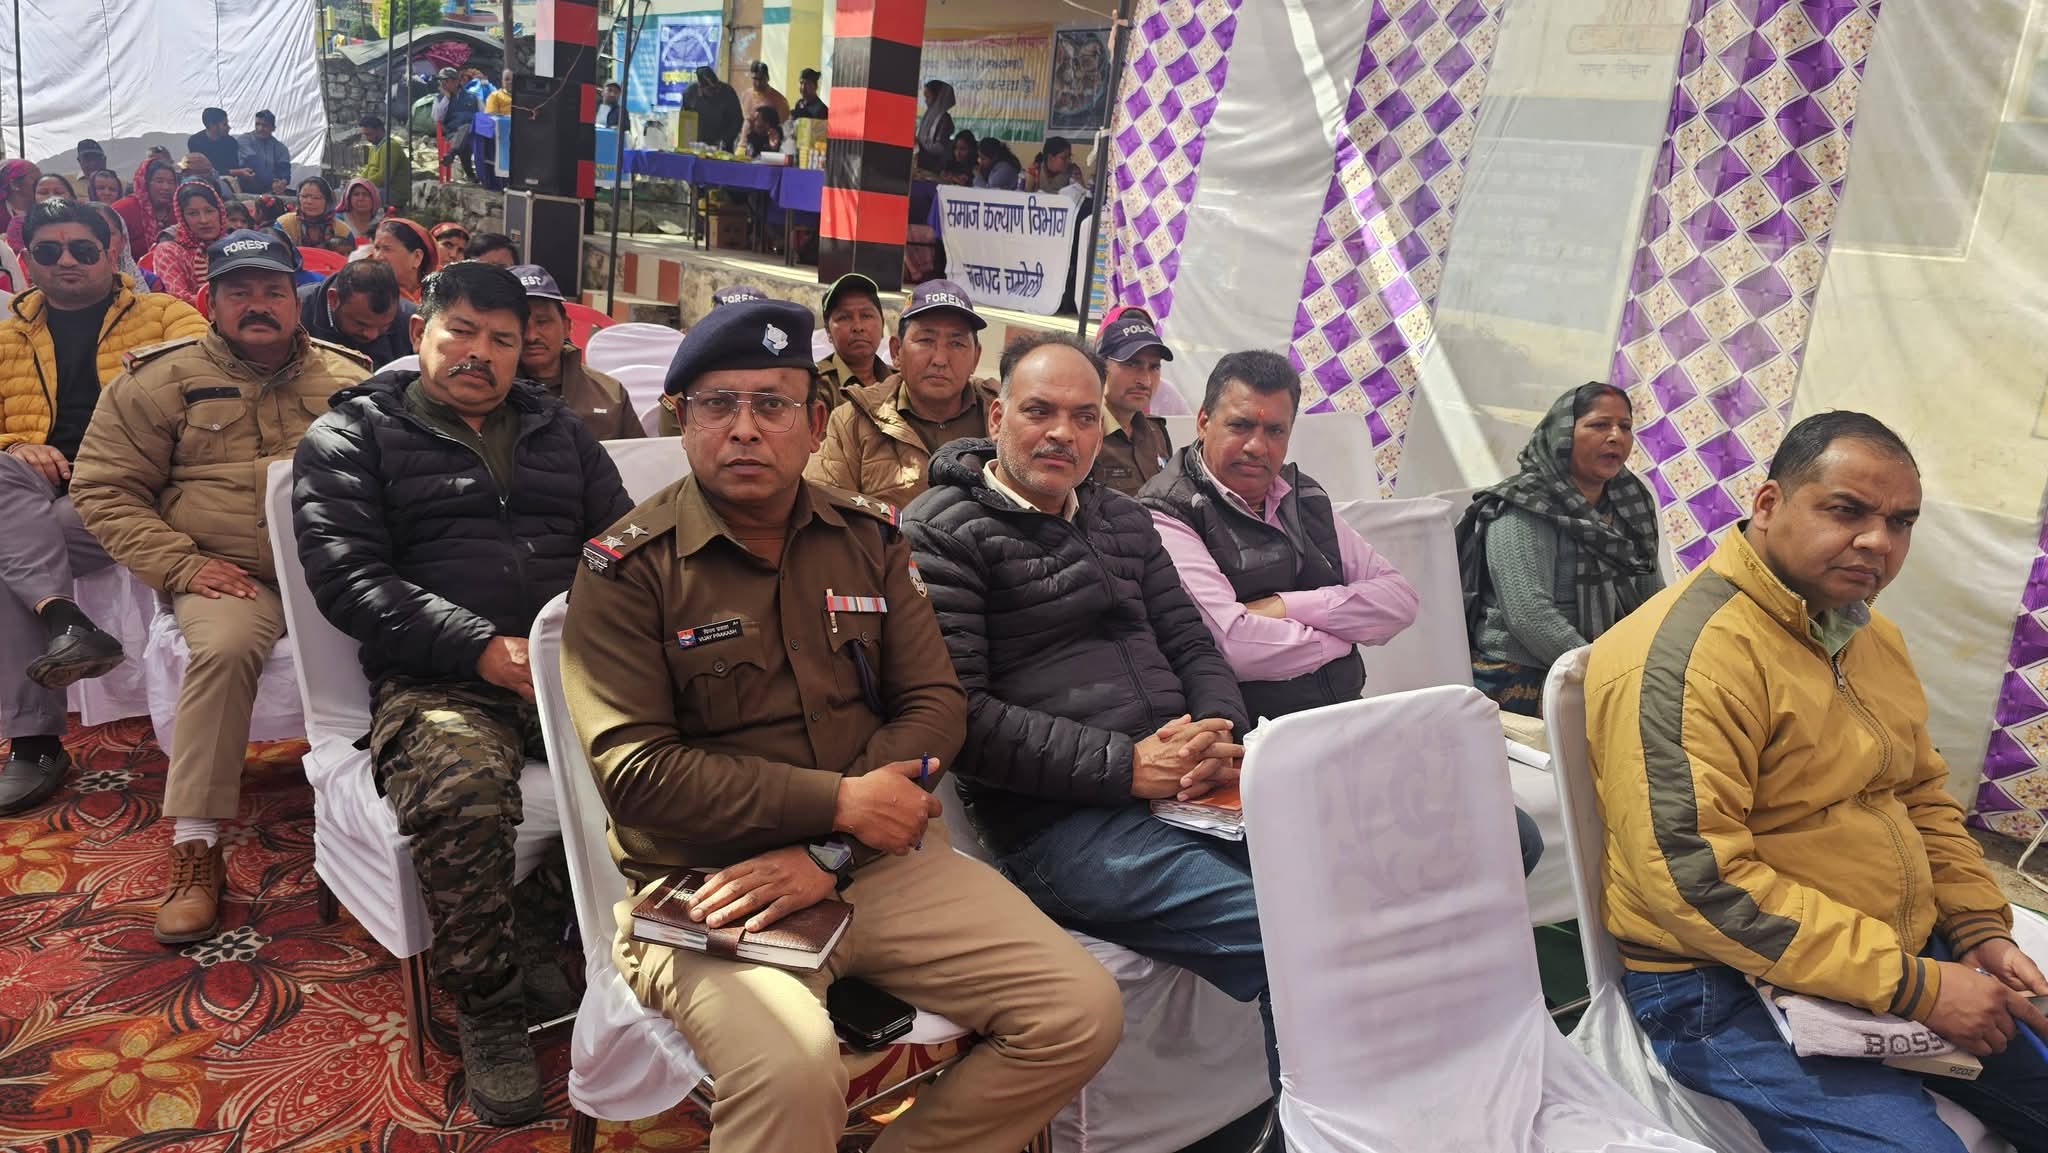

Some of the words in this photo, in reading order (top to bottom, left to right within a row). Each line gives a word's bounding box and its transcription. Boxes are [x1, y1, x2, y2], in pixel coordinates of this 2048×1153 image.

[947, 199, 980, 231] समाज
[983, 202, 1025, 235] कल्याण
[1028, 195, 1069, 238] विभाग
[223, 240, 270, 257] FOREST
[1004, 261, 1044, 298] चमोली
[1863, 1032, 1945, 1055] BOSS
